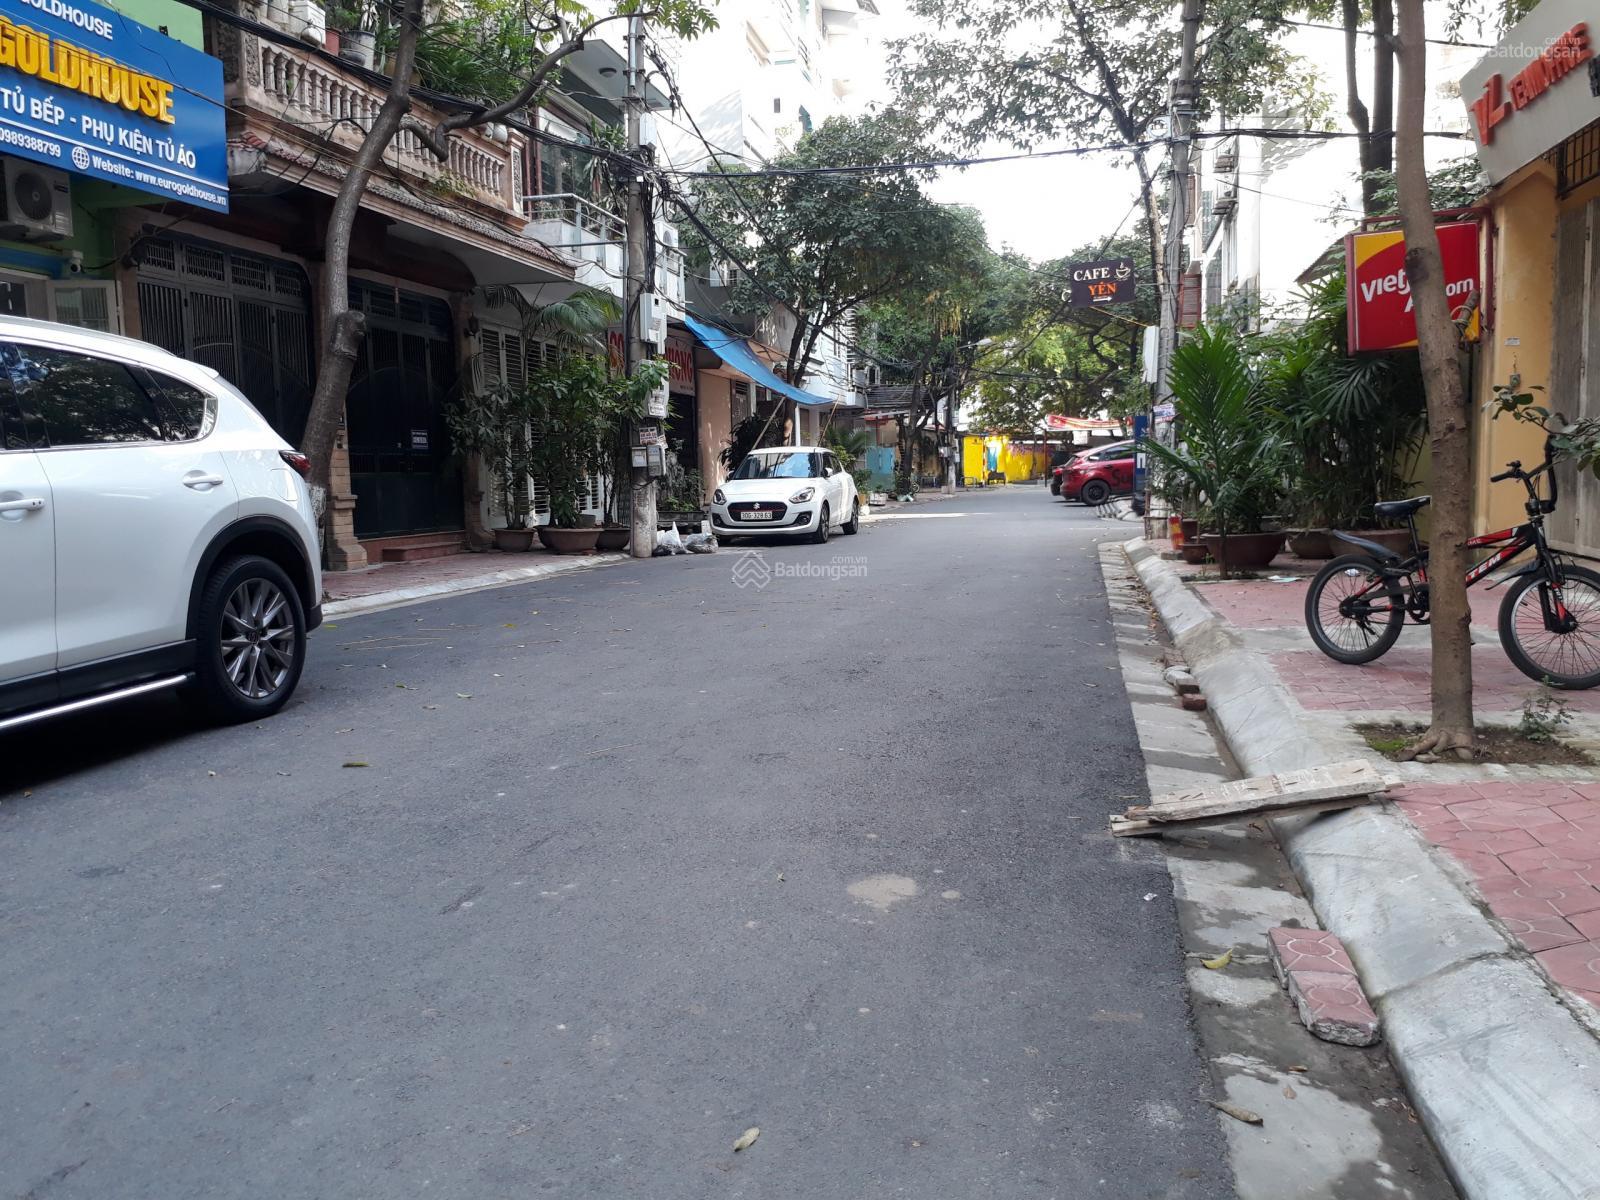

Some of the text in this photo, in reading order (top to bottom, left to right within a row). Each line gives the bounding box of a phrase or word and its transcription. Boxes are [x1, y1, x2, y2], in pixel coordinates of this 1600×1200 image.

[0, 15, 175, 124] GOLDHOUSE
[0, 86, 25, 114] TỦ
[30, 96, 65, 125] BẾP
[81, 115, 114, 146] PHỤ
[118, 127, 153, 155] KIỆN
[155, 137, 175, 162] TỦ
[177, 143, 196, 169] ÁO
[92, 154, 227, 206] Website: www.eurogoldhouse.vn
[1073, 267, 1110, 281] CAFE
